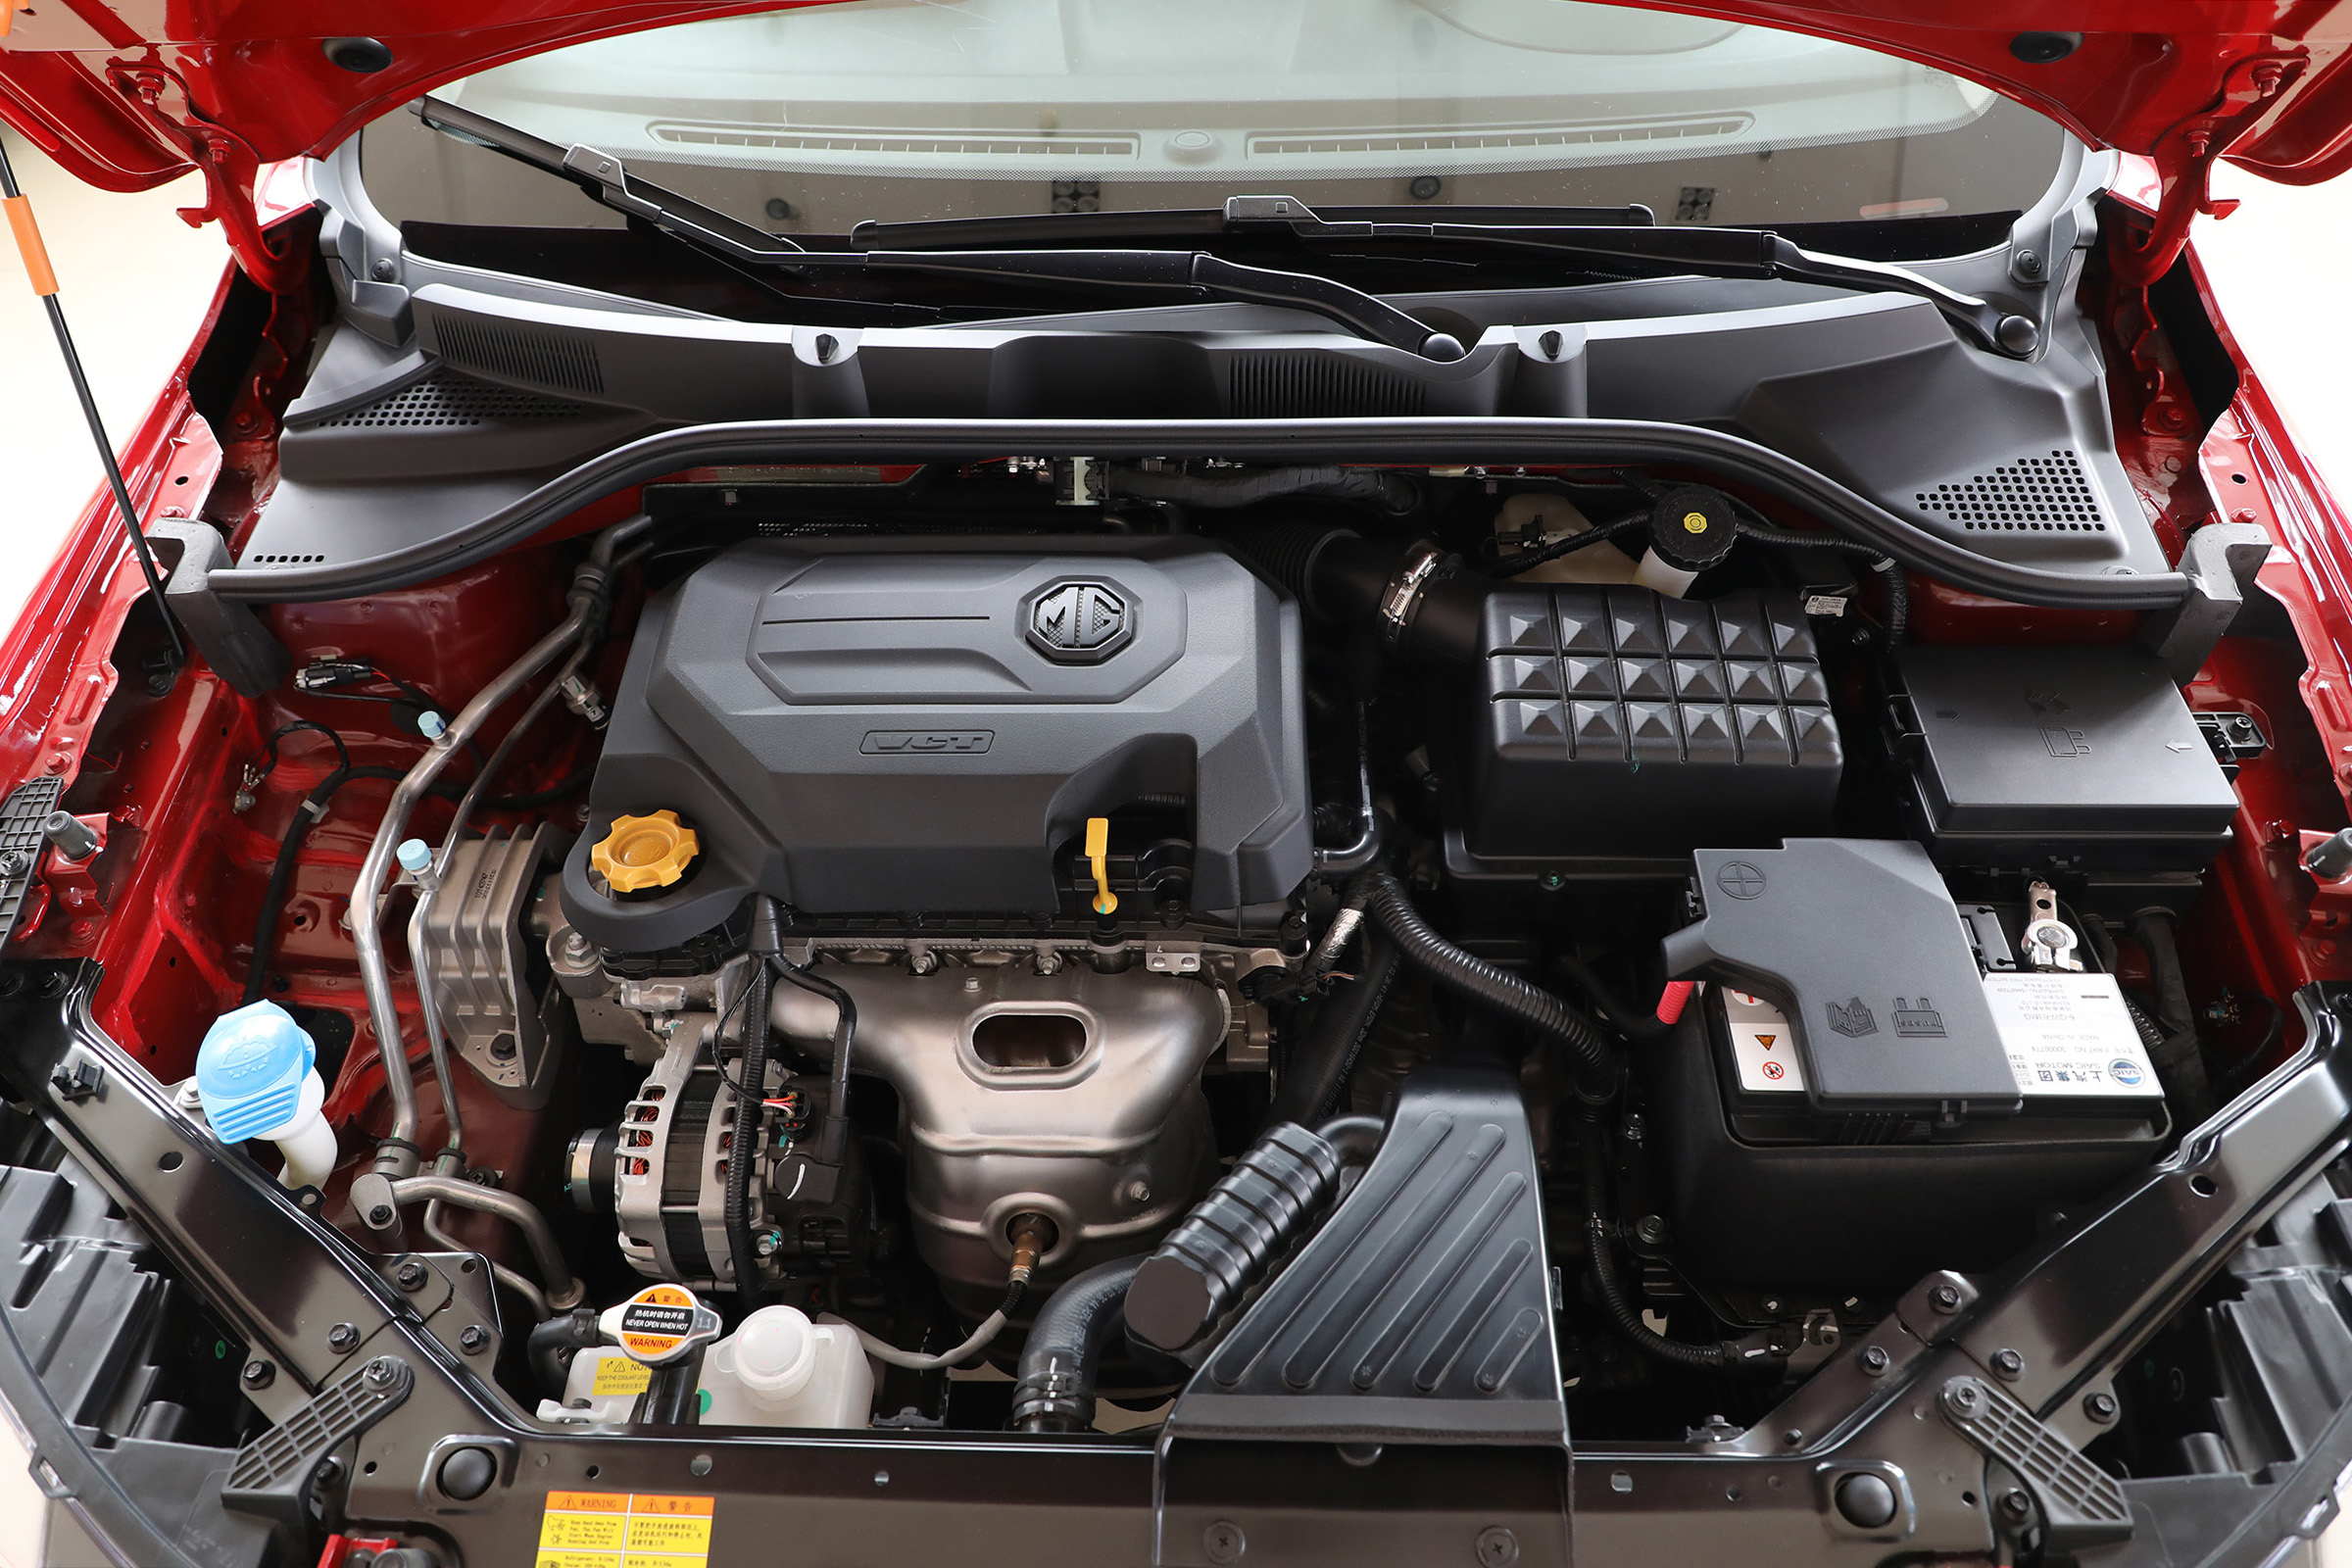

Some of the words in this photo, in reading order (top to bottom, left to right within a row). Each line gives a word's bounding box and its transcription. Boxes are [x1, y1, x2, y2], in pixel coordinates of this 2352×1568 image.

[1039, 587, 1120, 647] MG
[873, 735, 985, 750] VCT
[2037, 1070, 2102, 1082] 上汽集团
[635, 1309, 685, 1319] 热机时请勿开启
[660, 1321, 675, 1330] WHEN
[697, 1318, 711, 1329] 1.1
[630, 1338, 672, 1348] WARNING
[581, 1498, 616, 1508] WARNING
[669, 1500, 692, 1512] 警告
